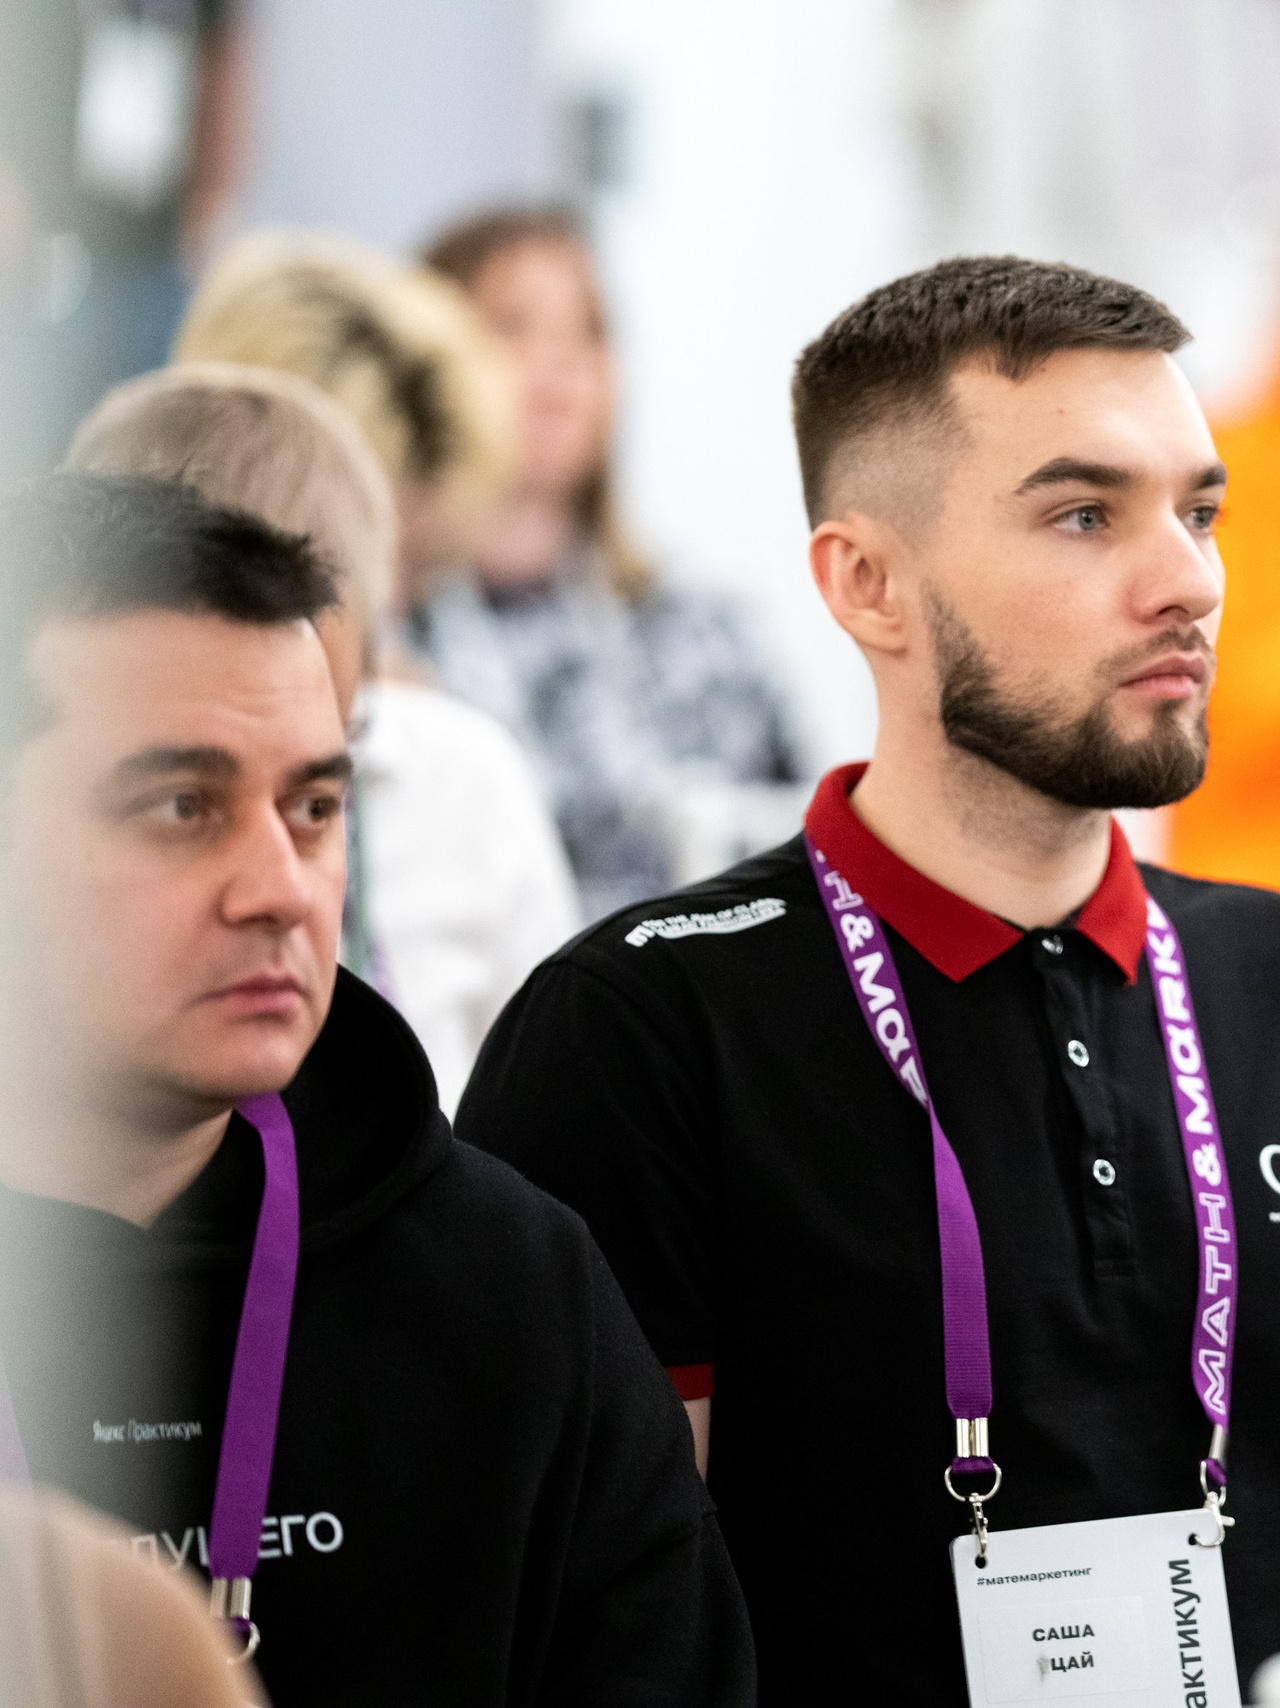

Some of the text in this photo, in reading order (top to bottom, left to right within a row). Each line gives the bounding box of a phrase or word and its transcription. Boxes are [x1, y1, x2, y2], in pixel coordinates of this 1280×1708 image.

[839, 913, 874, 952] &
[1192, 1143, 1222, 1186] &
[1198, 1192, 1233, 1415] MATH
[976, 1567, 1093, 1587] #матемаркетинг
[1032, 1624, 1095, 1642] САША
[1051, 1651, 1095, 1673] ЦАЙ
